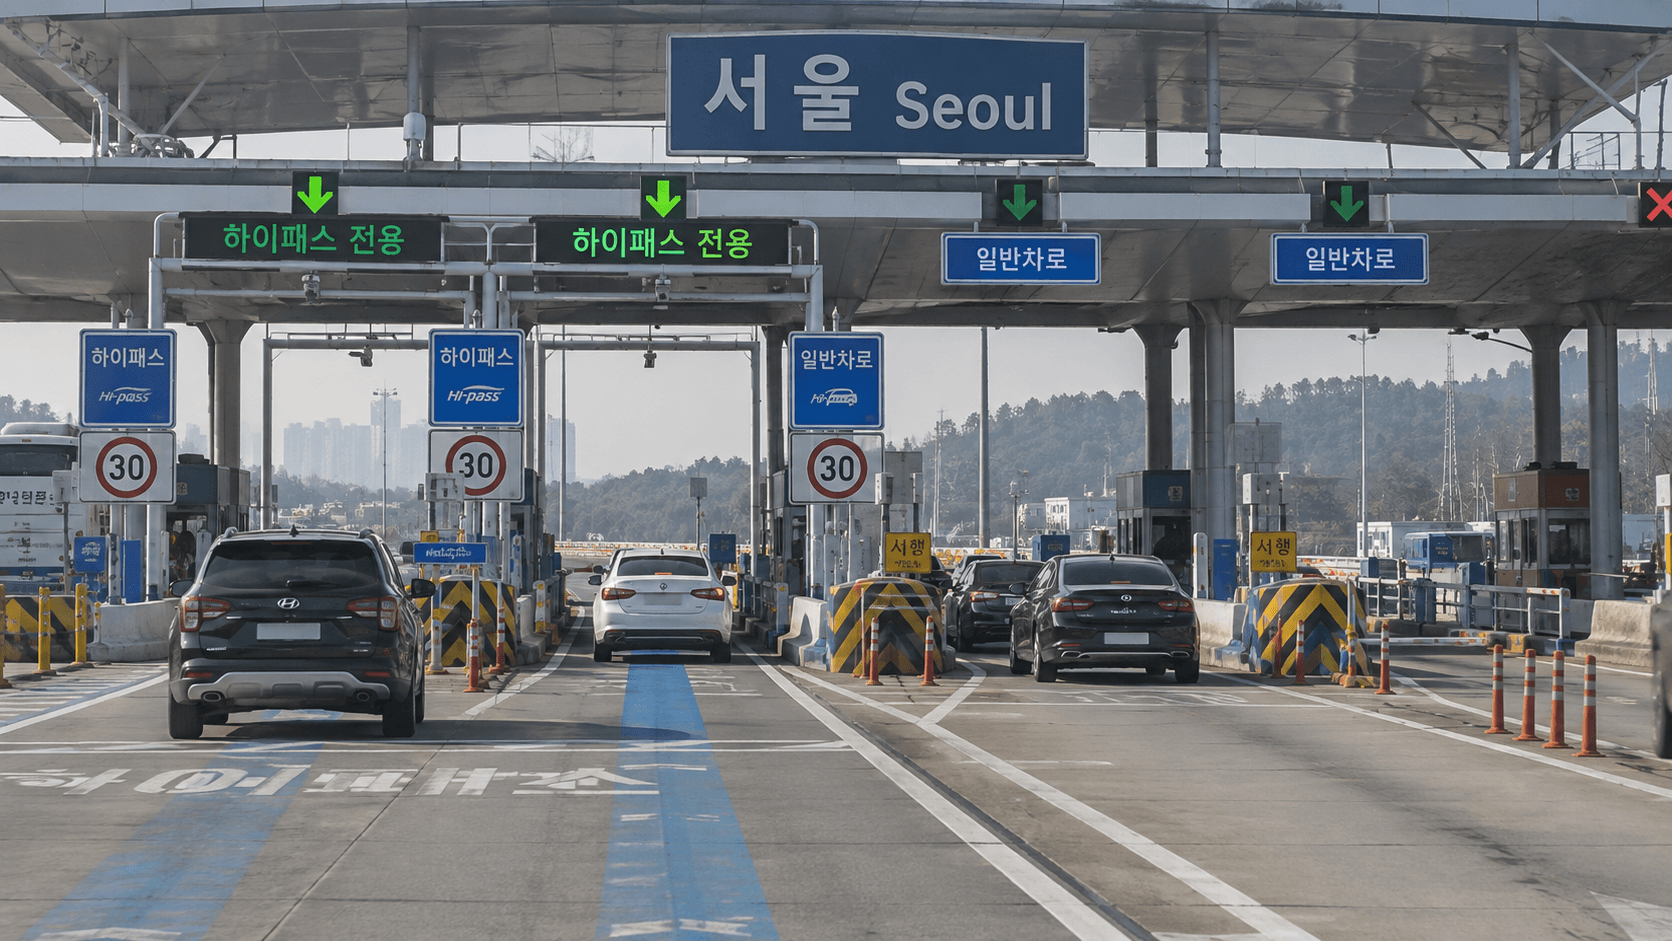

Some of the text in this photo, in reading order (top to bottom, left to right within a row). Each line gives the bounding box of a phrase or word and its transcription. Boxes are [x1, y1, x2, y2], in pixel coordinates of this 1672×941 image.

[703, 53, 1052, 132] 서울 Seoul
[223, 223, 405, 256] 하이패스 전용
[572, 226, 753, 260] 하이패스 전용
[976, 246, 1067, 272] 일반차로
[1306, 247, 1396, 272] 일반차로
[91, 346, 165, 369] 하이패스
[439, 346, 514, 368] 하이패스
[801, 349, 873, 371] 일반차로
[109, 453, 144, 481] 30
[459, 452, 493, 478] 30
[820, 455, 855, 482] 30
[890, 538, 925, 557] 서행
[1256, 537, 1291, 556] 서행
